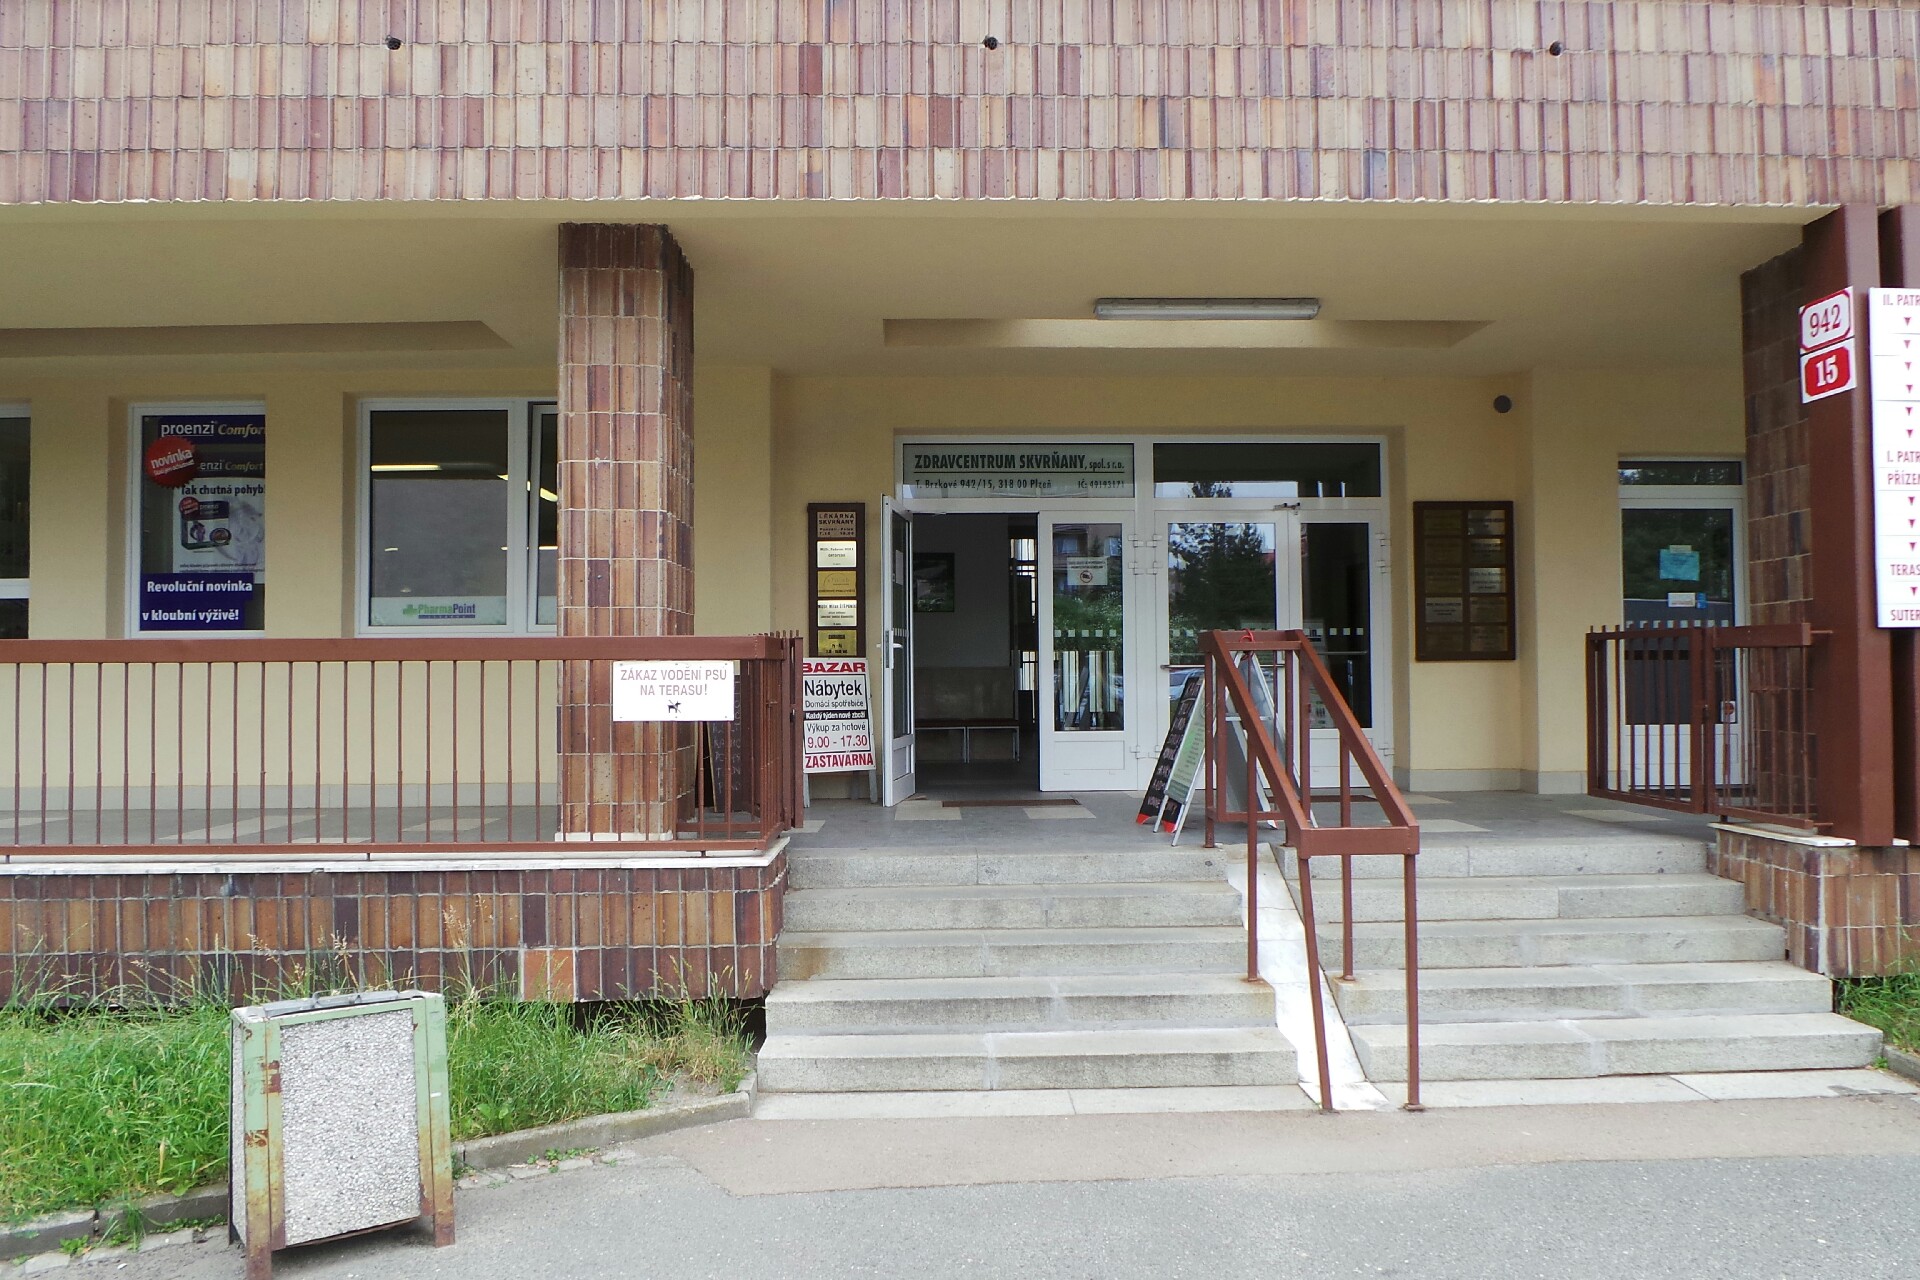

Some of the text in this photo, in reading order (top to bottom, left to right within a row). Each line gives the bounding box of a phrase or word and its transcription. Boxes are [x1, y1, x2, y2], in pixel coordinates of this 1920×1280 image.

[1809, 304, 1841, 338] 942
[1815, 354, 1839, 387] 15
[161, 420, 265, 438] proenzi Comfor
[150, 448, 193, 469] novinka
[914, 454, 1016, 469] ZDRAVCENTRUM
[1019, 451, 1087, 470] SKVRŇANY,
[199, 484, 233, 495] chutná
[960, 479, 995, 491] 942/15,
[998, 479, 1014, 489] 318
[1017, 479, 1027, 489] 00
[147, 580, 253, 593] Revoluční novinka
[142, 608, 240, 624] v kloubní výživě!
[620, 667, 657, 681] ZÁKAZ
[660, 666, 702, 681] VODĚNÍ
[802, 661, 866, 673] BAZAR
[639, 683, 708, 696] NA TERASU!
[804, 680, 863, 700] Nábytek
[805, 699, 864, 709] Domácí spotřebiče
[806, 721, 866, 734] Výkup za hotové
[807, 736, 830, 749] 9.00
[841, 734, 868, 747] 17.30
